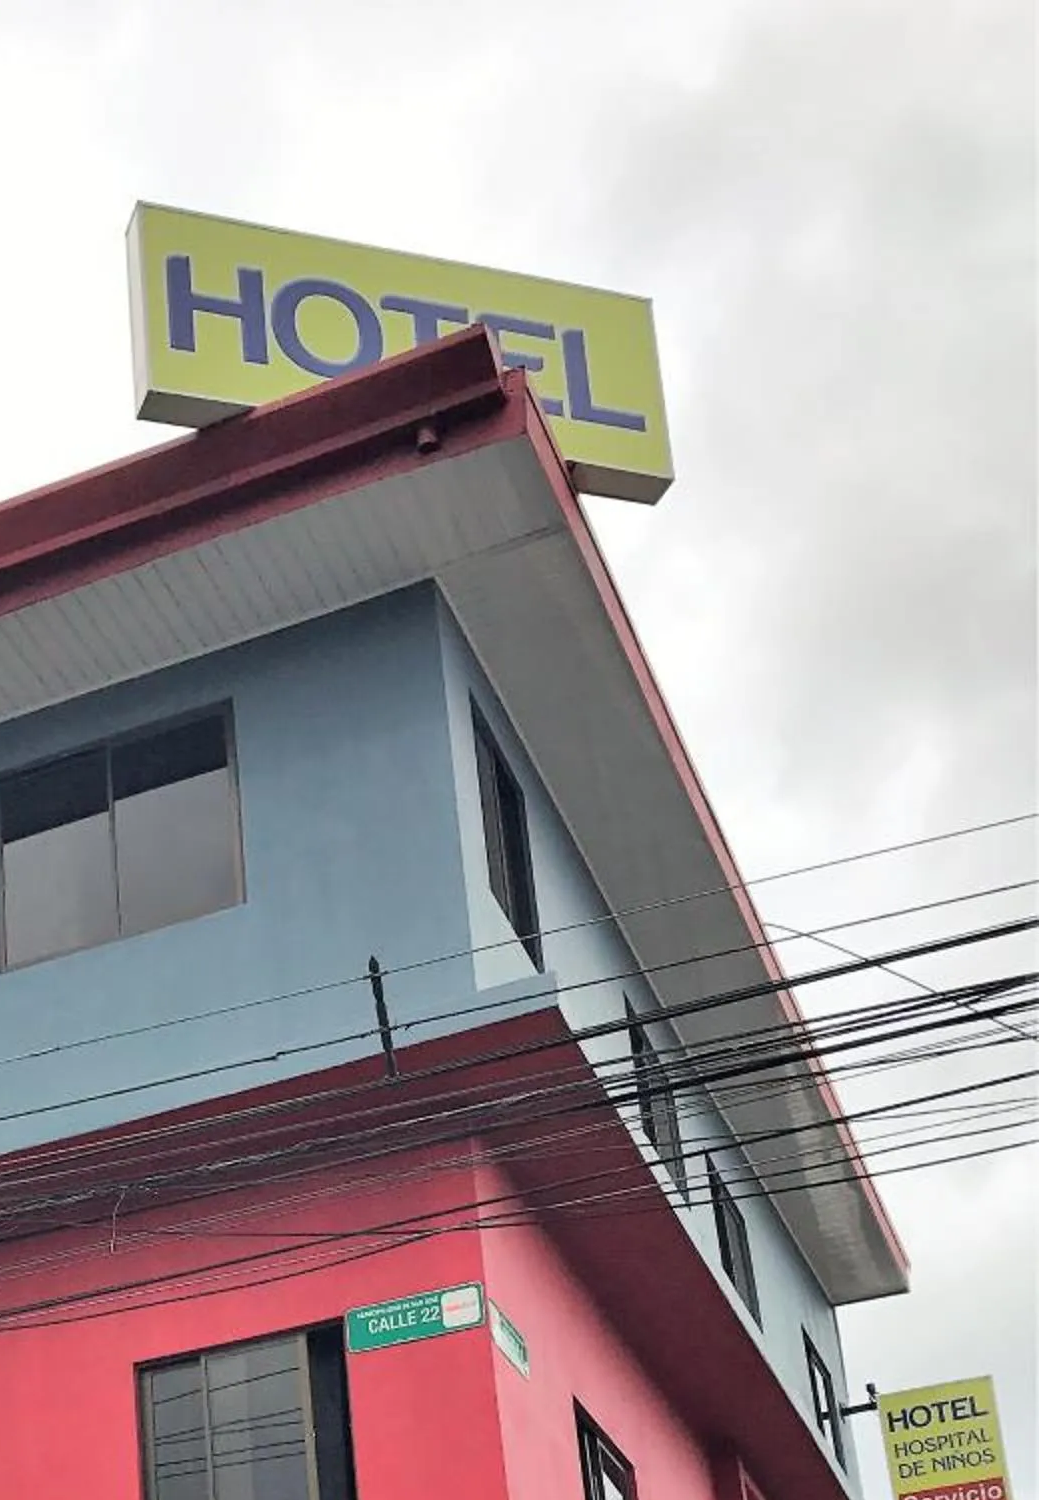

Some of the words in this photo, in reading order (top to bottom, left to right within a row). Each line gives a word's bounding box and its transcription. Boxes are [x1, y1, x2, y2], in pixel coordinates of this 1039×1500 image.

[368, 1310, 417, 1334] CALLE
[421, 1306, 441, 1323] 22
[887, 1396, 989, 1432] HOTEL
[894, 1428, 990, 1458] HOSPITAL
[899, 1460, 926, 1478] DE
